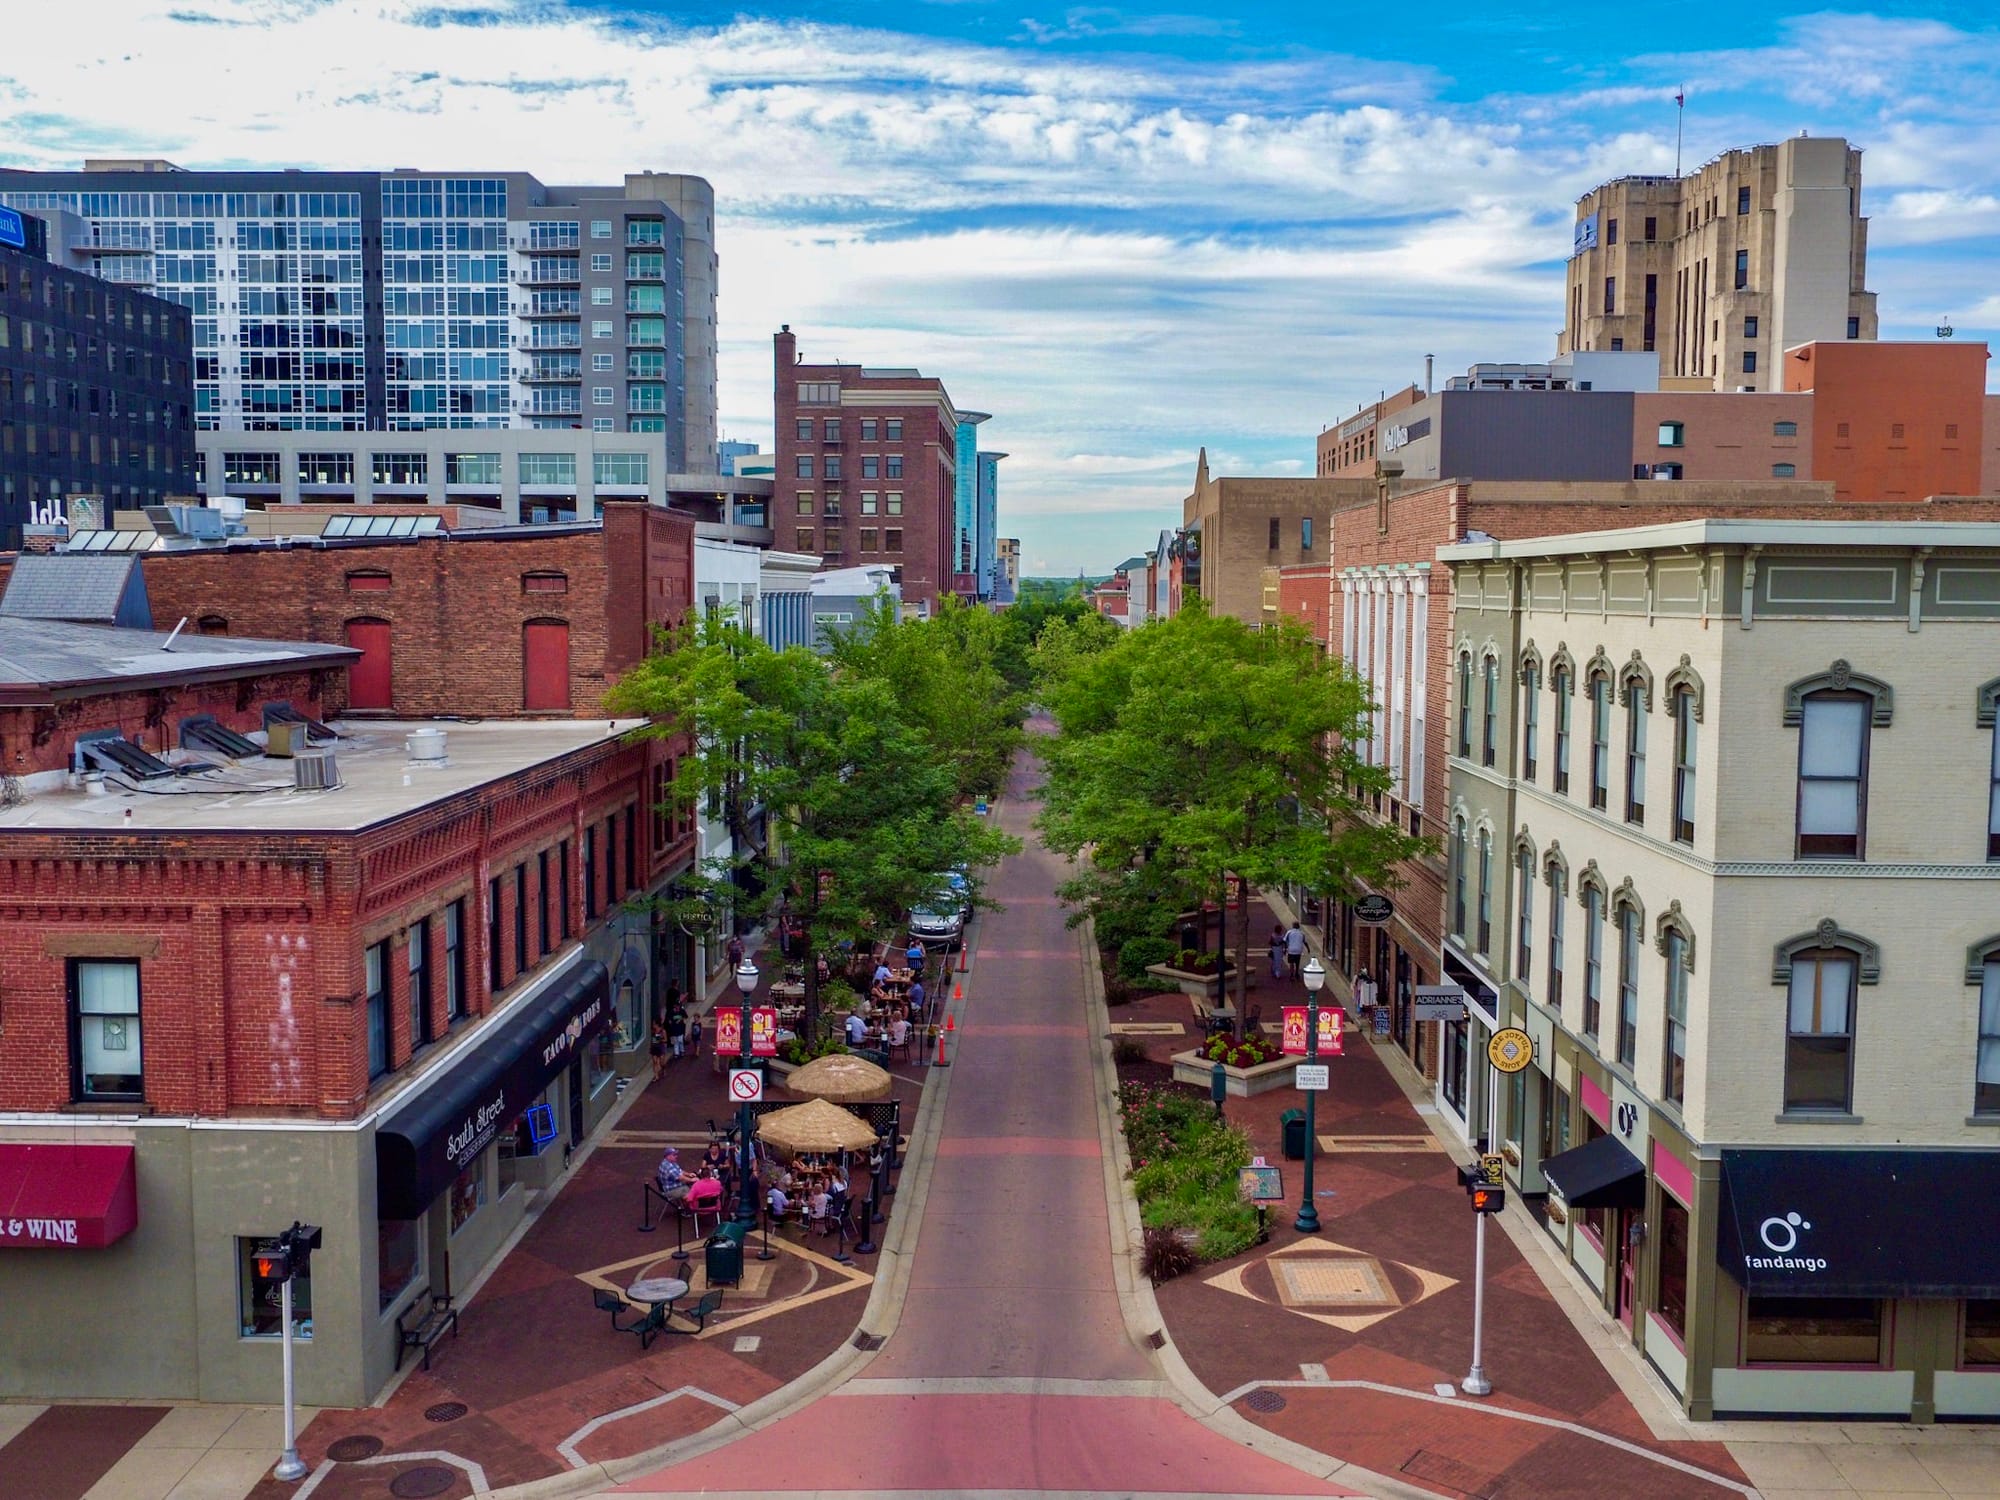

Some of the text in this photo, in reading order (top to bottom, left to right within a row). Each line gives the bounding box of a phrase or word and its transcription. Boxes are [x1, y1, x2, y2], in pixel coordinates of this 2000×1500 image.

[543, 1033, 566, 1067] TACO
[1492, 1032, 1529, 1051] BEE JOYFUL
[1500, 1060, 1521, 1070] SHOP
[447, 1116, 475, 1161] South
[476, 1088, 506, 1133] Street
[8, 1218, 24, 1237] &
[25, 1218, 78, 1244] WINE
[1744, 1255, 1828, 1272] fandango
